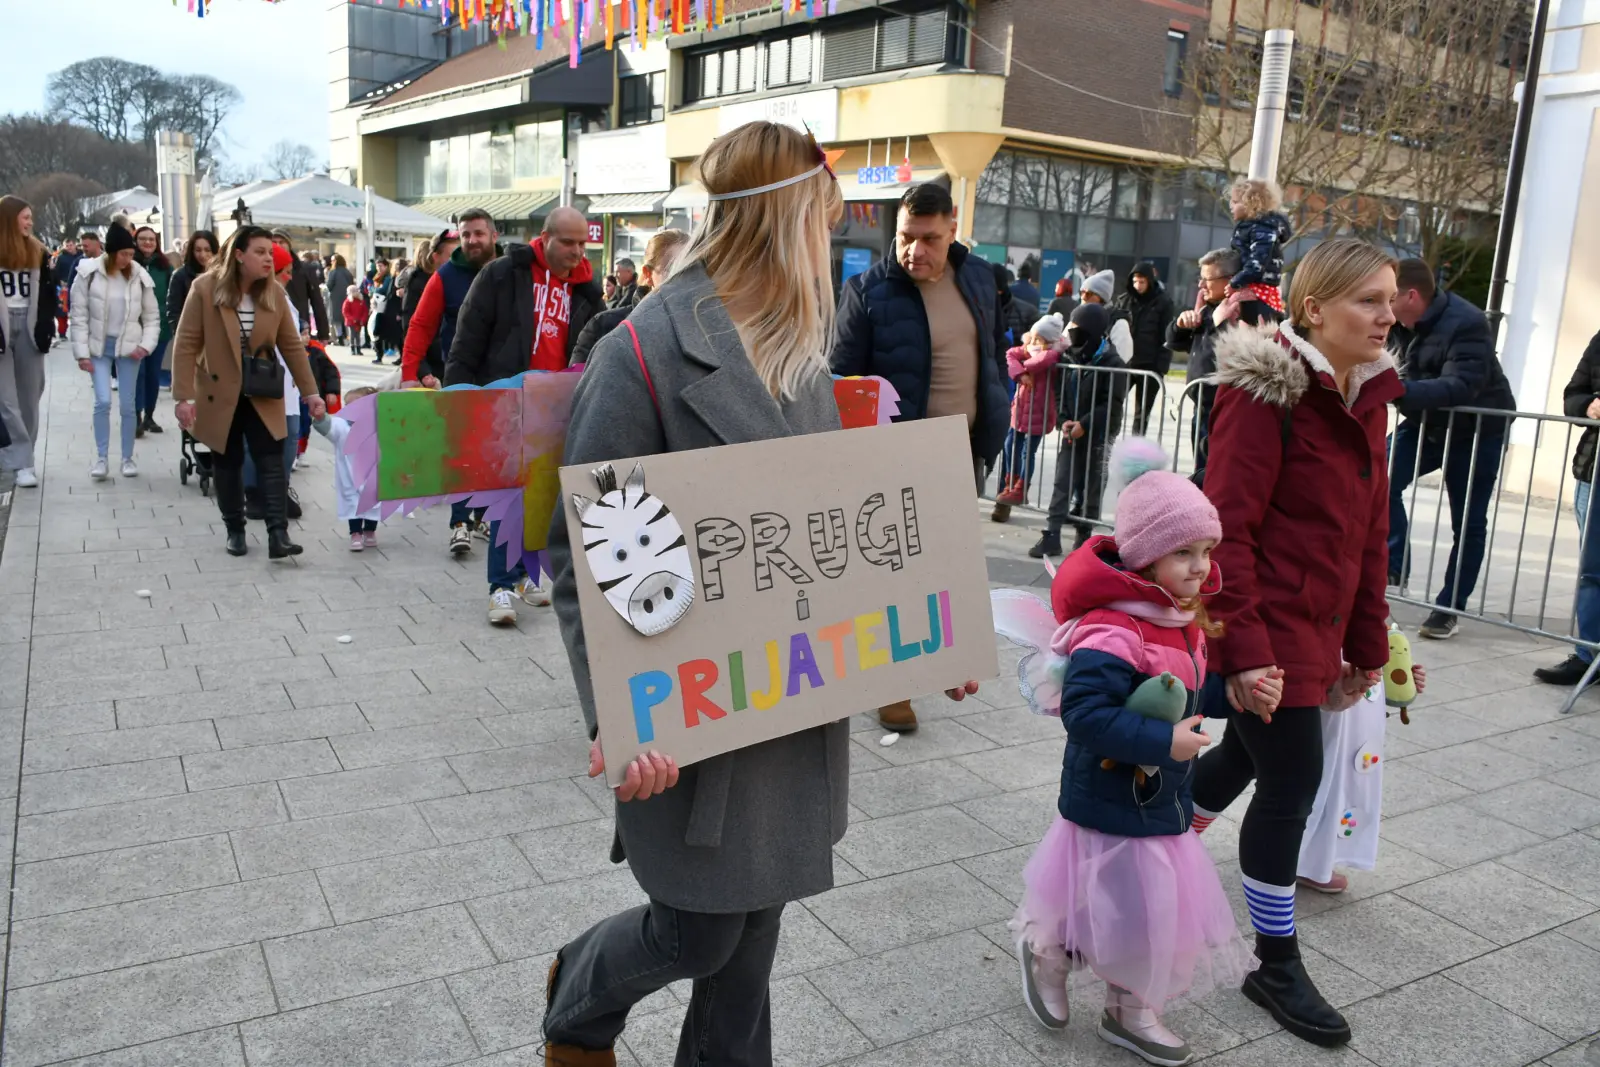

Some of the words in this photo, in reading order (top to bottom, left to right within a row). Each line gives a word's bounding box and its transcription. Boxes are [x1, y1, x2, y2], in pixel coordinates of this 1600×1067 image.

[857, 166, 898, 184] ERSTE
[589, 225, 601, 241] T
[0, 271, 30, 297] 86
[695, 487, 921, 602] PRUGI
[796, 590, 810, 620] i
[628, 590, 953, 744] PRIJATELJI
